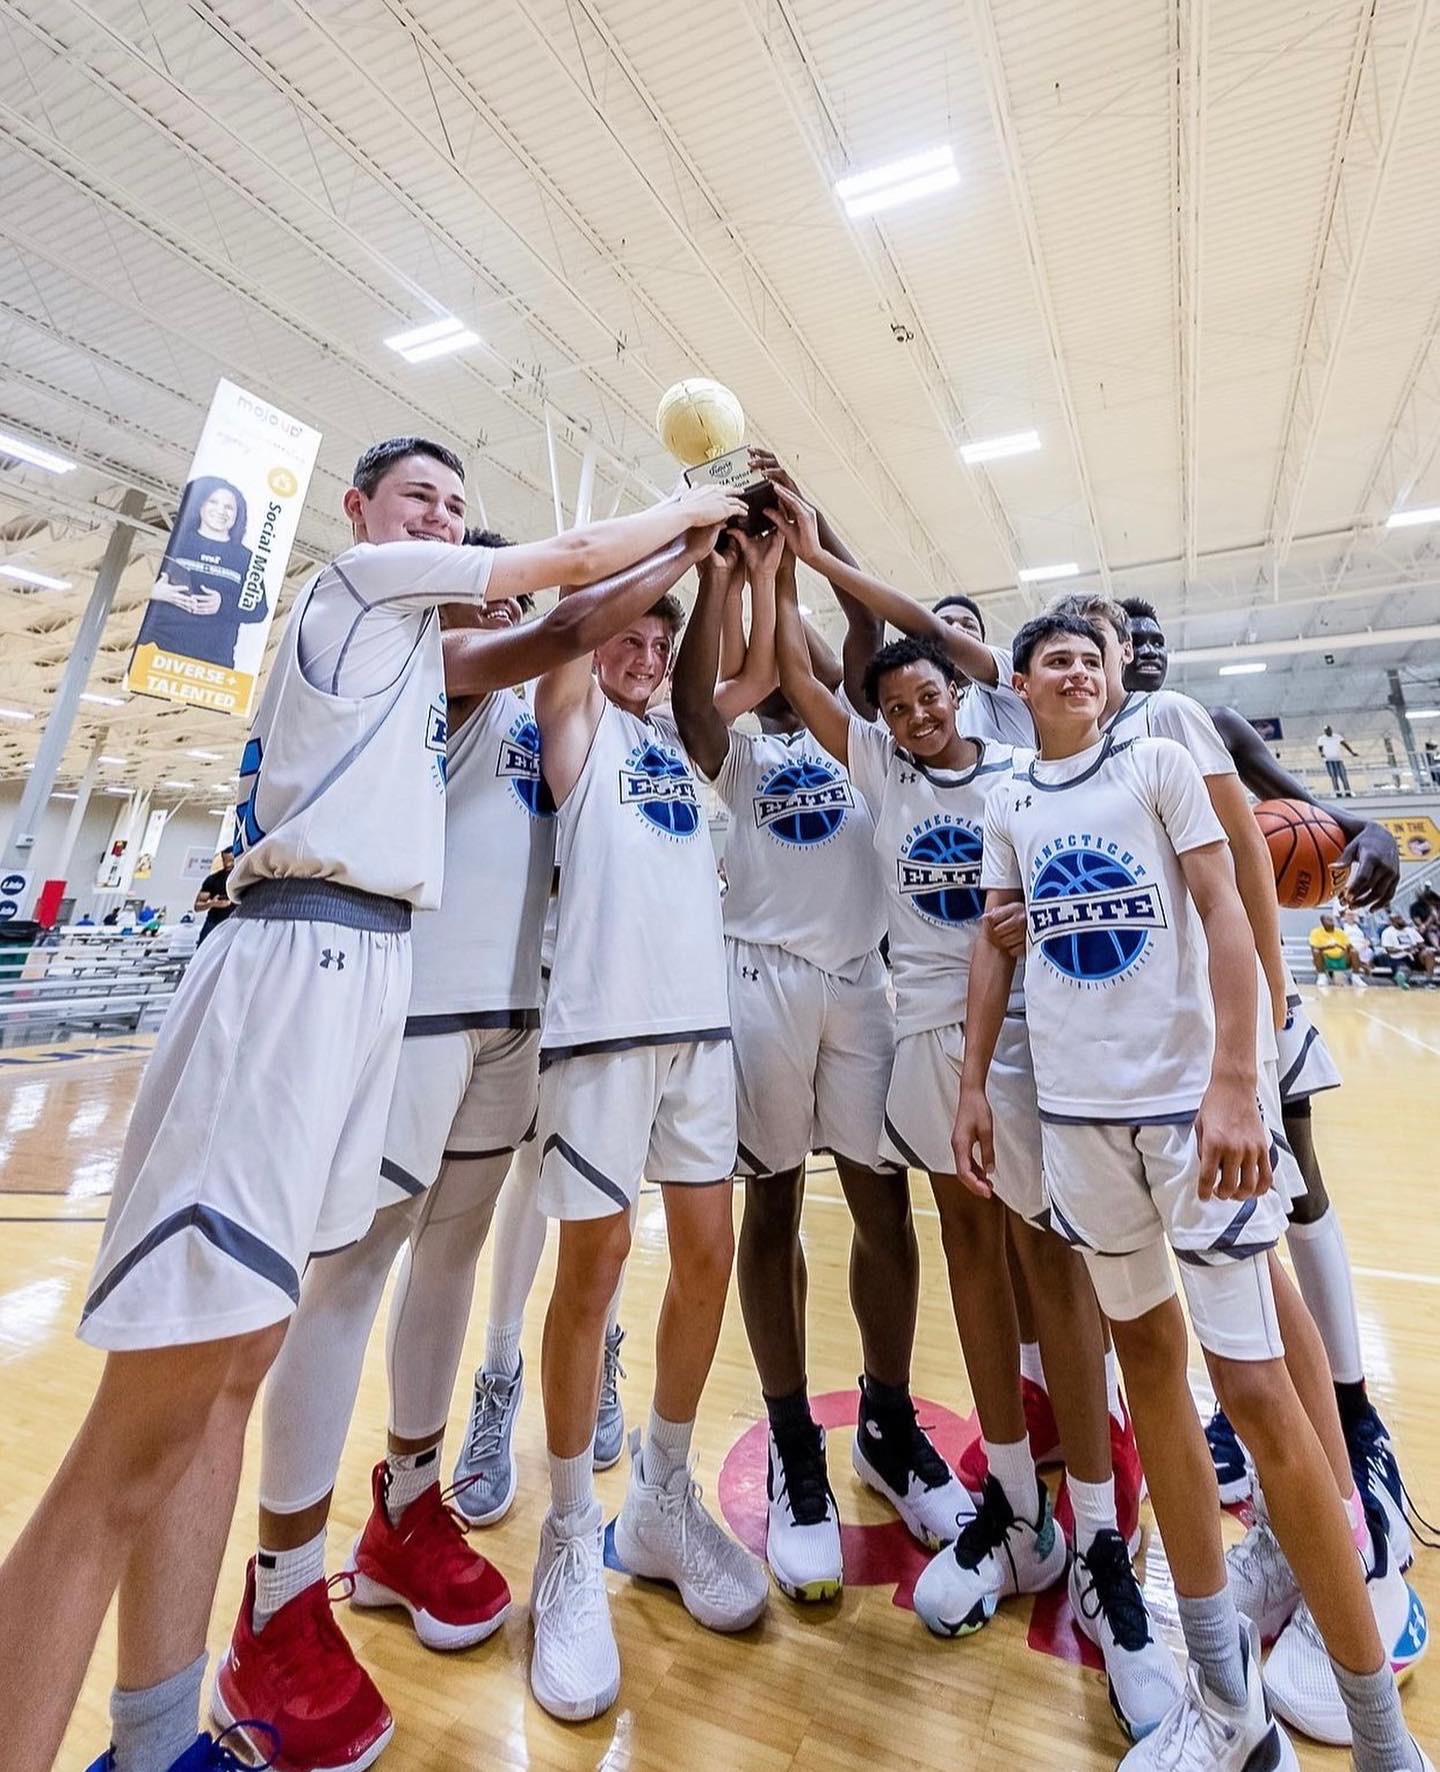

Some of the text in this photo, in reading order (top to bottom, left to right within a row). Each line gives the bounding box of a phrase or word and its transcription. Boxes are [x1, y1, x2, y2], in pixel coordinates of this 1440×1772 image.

[242, 502, 281, 609] Social Media
[152, 654, 226, 685] DIVERSE
[147, 676, 236, 707] TALENTED
[759, 786, 848, 820] ELITE
[900, 814, 984, 855] CONNECTIC
[902, 867, 981, 886] ELIT
[1029, 834, 1147, 893] NNECTICUT
[1029, 893, 1156, 934] ELITE
